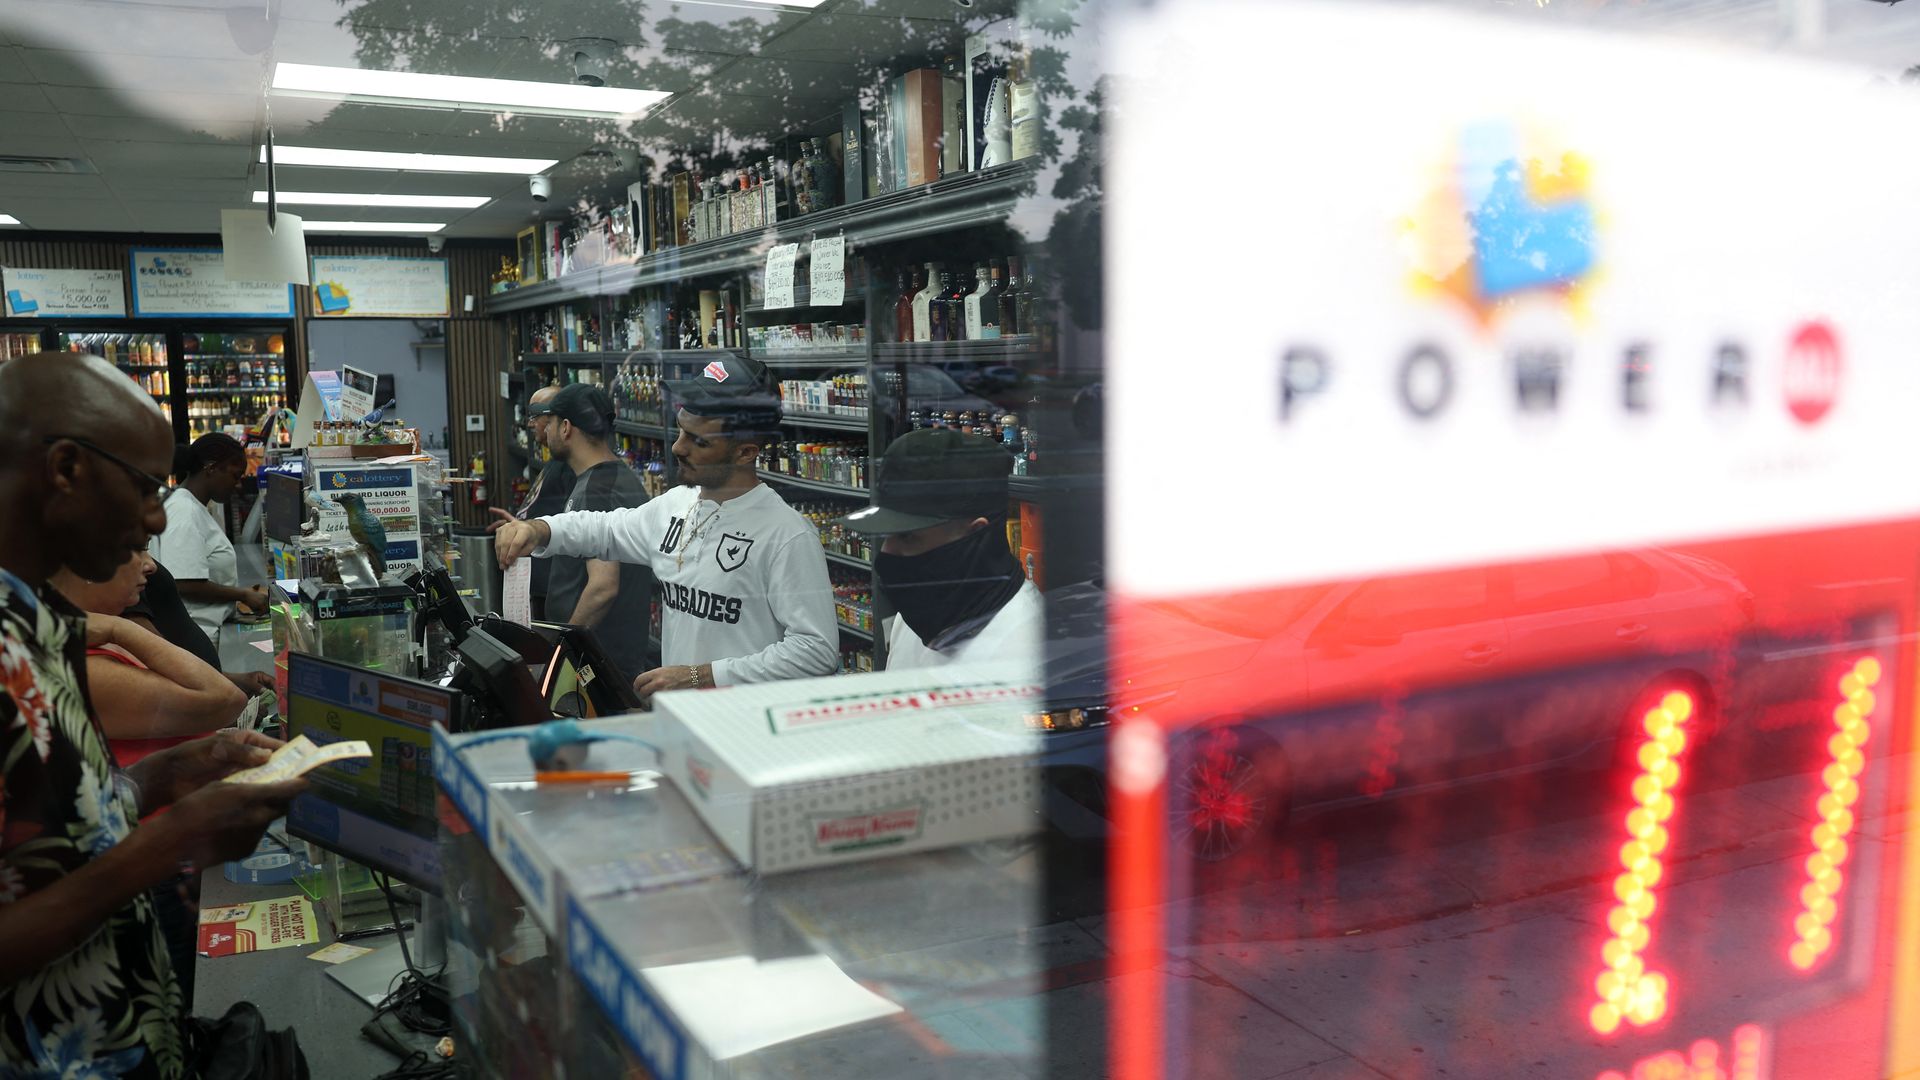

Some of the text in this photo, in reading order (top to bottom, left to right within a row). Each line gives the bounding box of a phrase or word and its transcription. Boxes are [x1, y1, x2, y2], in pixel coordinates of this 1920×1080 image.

[349, 474, 402, 483] calottery
[375, 490, 407, 498] LIQUOR
[659, 516, 685, 554] 10
[319, 607, 336, 619] blu
